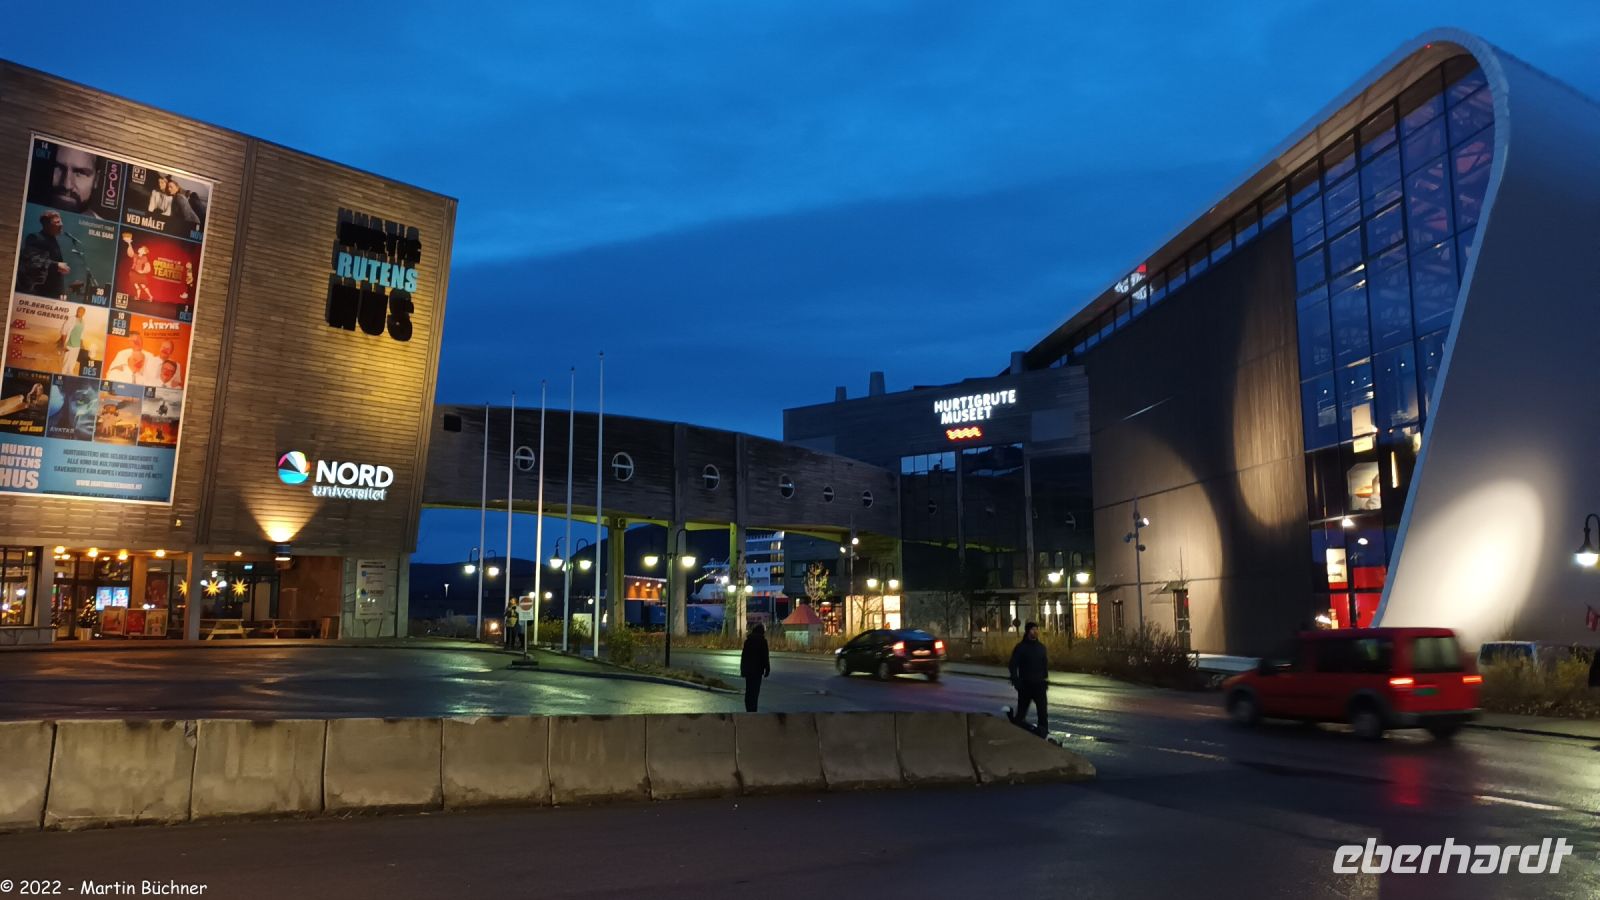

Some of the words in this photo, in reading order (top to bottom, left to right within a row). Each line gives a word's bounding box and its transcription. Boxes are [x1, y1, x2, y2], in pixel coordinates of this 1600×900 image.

[106, 163, 118, 199] SOLO
[126, 213, 141, 226] VED
[141, 216, 166, 231] MÅLET
[336, 251, 419, 293] RUTENS
[91, 295, 107, 305] NOV
[16, 307, 36, 315] UTEN
[36, 310, 69, 321] GRENSER
[113, 318, 127, 328] FEB
[82, 366, 97, 376] DES
[934, 389, 1017, 413] HURTIGRUTE
[941, 405, 992, 425] MUSEET
[1, 443, 44, 458] HURTIG
[0, 455, 42, 469] RUTENS
[0, 467, 40, 490] HUS
[316, 459, 394, 488] NORD
[312, 484, 387, 501] universitet
